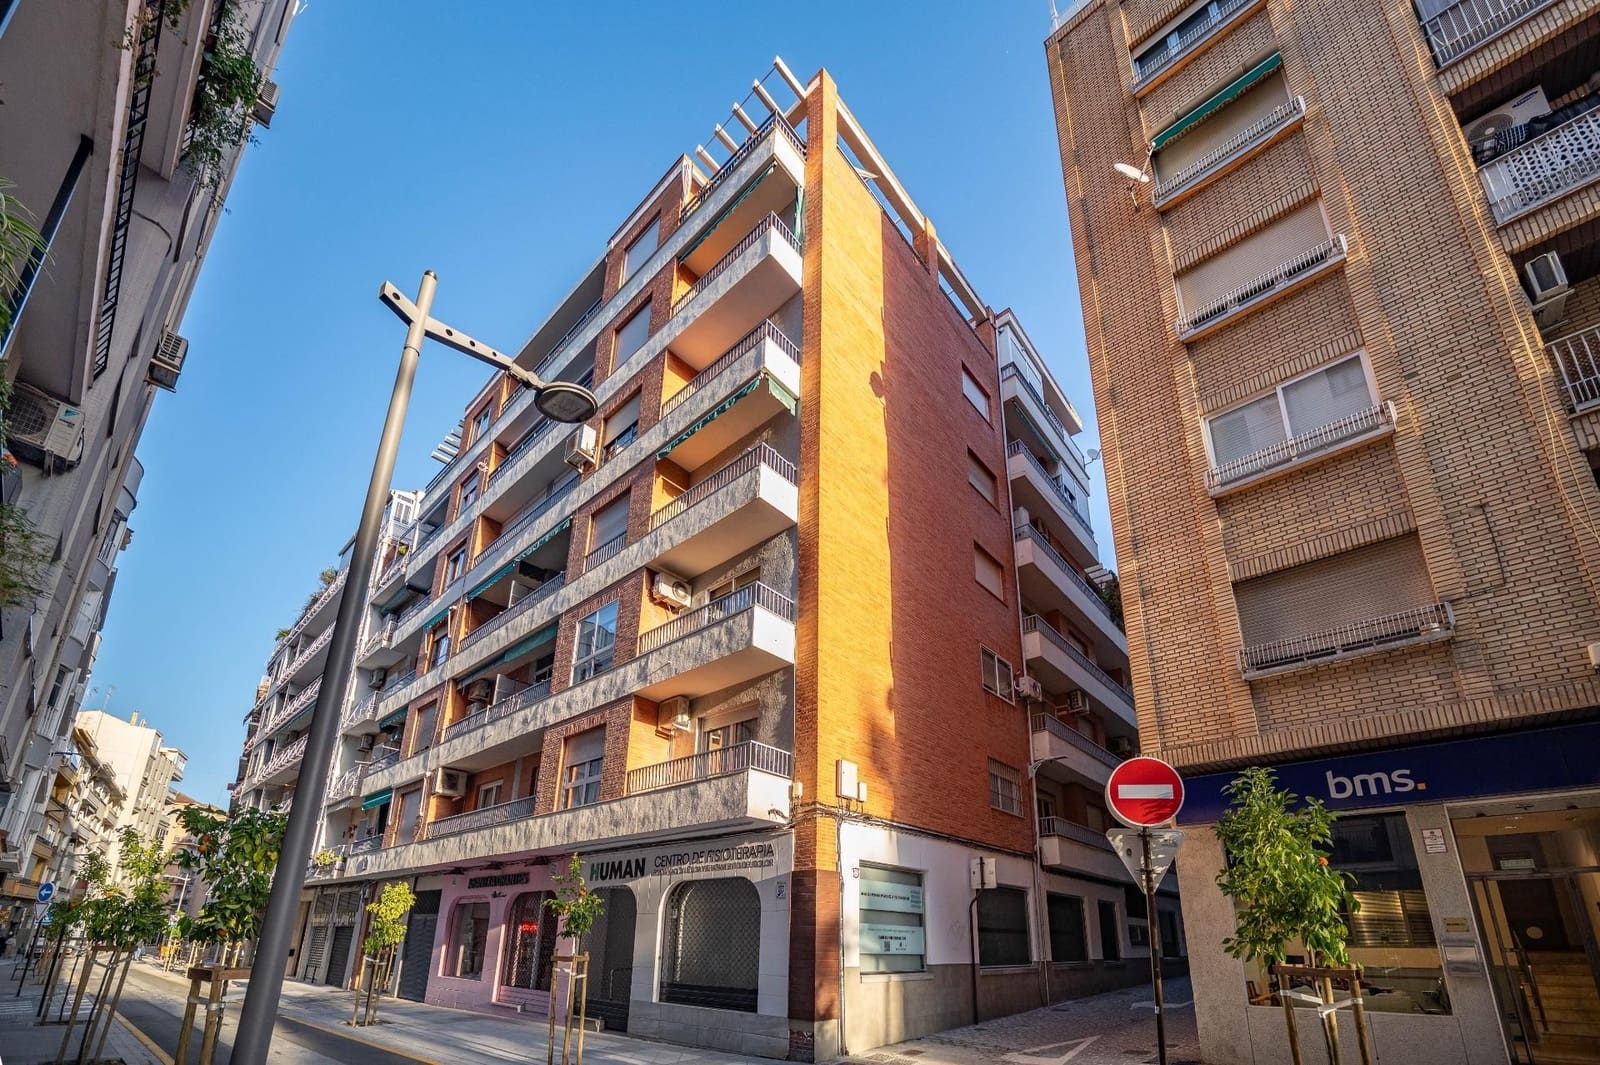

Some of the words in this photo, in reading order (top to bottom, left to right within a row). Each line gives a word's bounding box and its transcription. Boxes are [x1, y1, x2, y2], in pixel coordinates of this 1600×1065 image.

[1325, 769, 1426, 799] bms.
[654, 852, 690, 868] CENTRO
[692, 850, 705, 864] DE
[706, 843, 775, 863] FISIOTERAPIA
[589, 857, 646, 882] HUMAN
